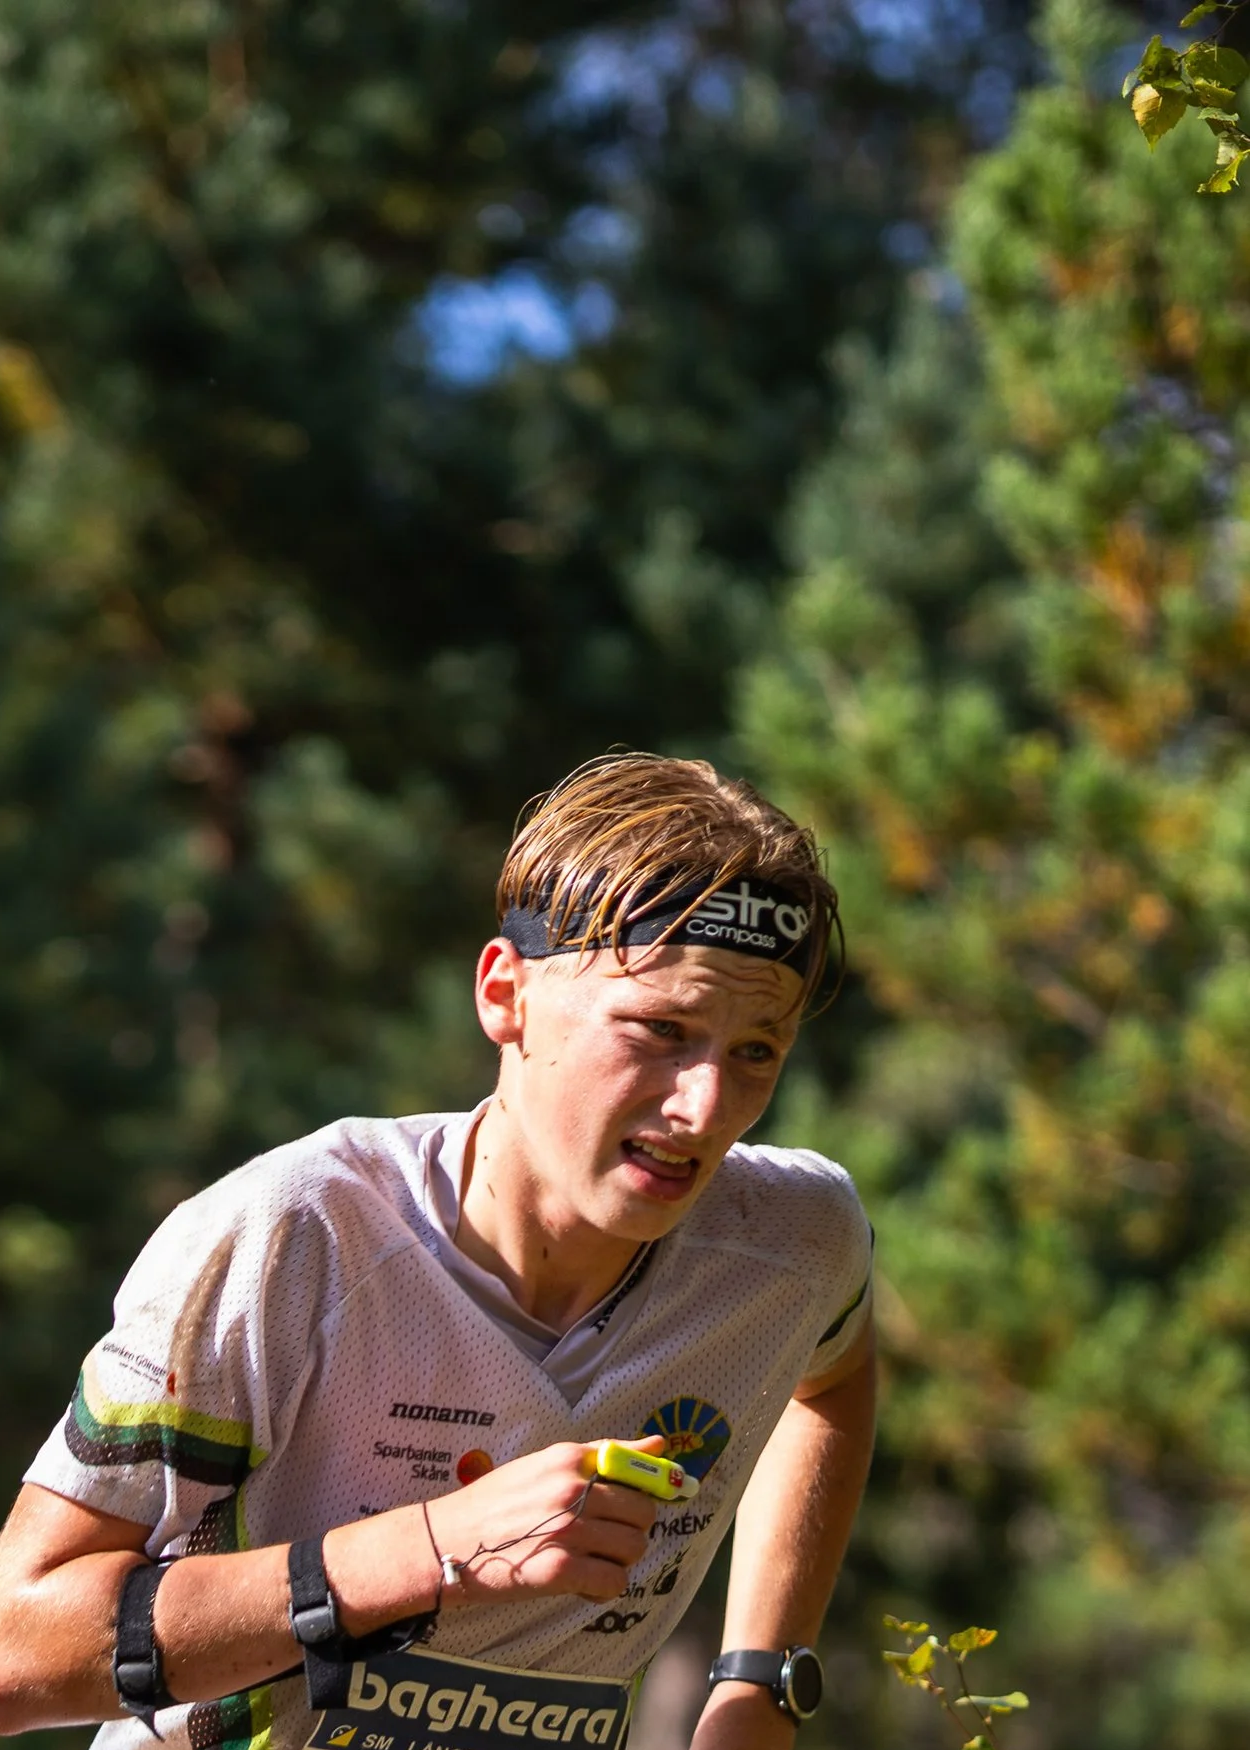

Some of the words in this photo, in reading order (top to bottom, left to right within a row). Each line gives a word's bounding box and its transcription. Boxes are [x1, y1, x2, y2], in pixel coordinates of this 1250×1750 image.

[686, 919, 777, 949] Compass
[388, 1403, 496, 1427] noname
[373, 1441, 452, 1464] Sparbanken
[411, 1464, 450, 1482] Skåne
[347, 1661, 618, 1745] bagheera
